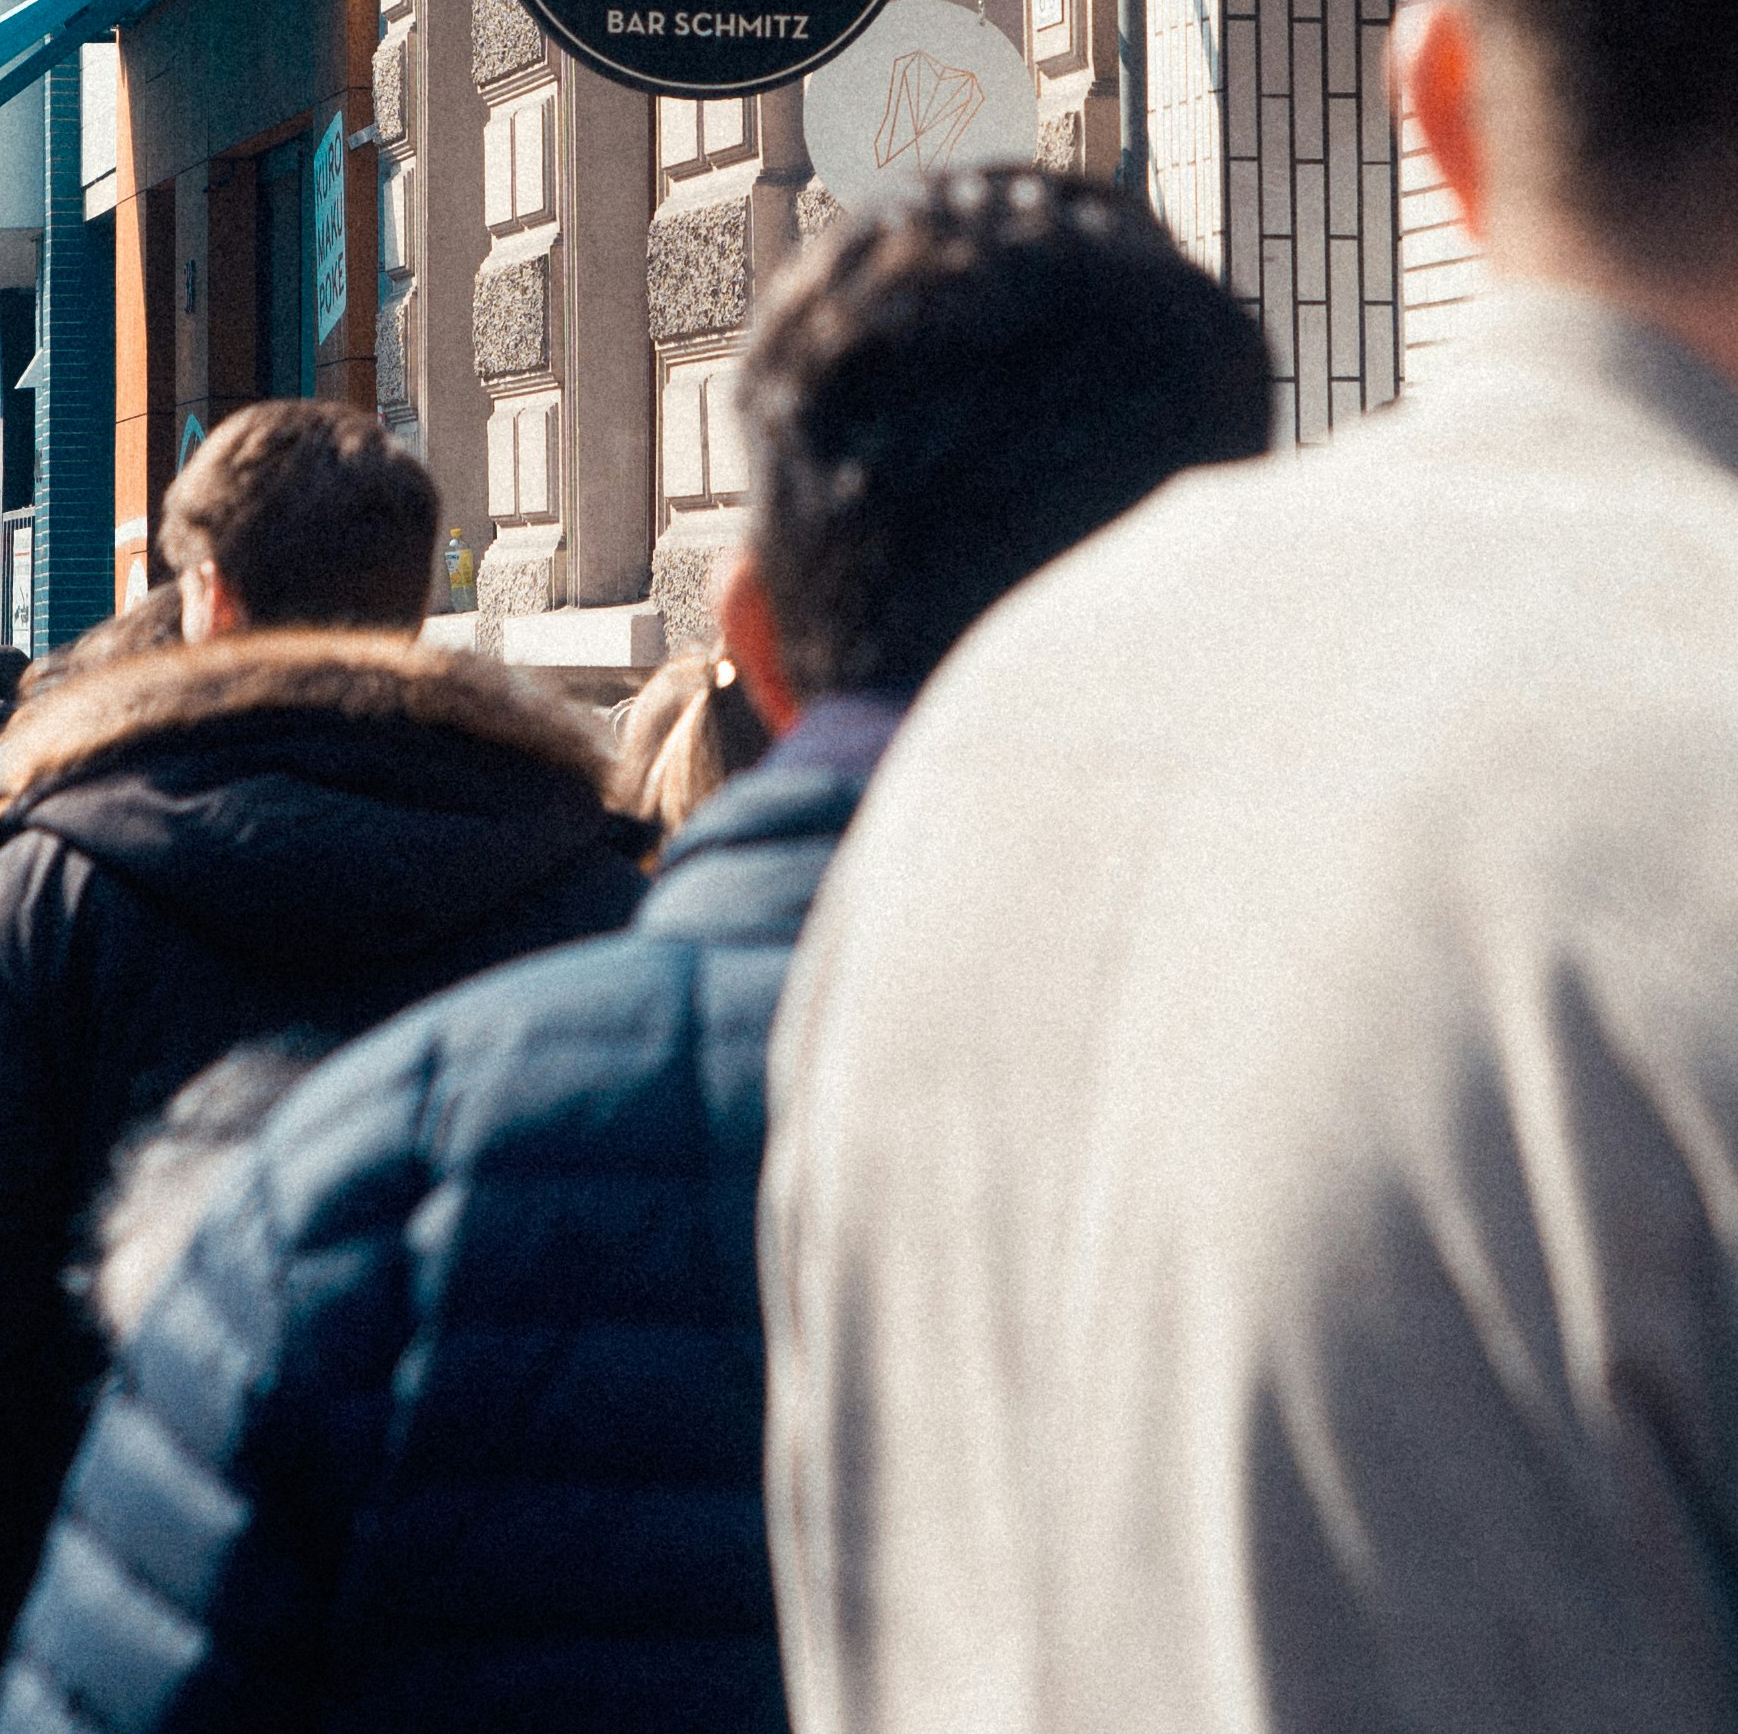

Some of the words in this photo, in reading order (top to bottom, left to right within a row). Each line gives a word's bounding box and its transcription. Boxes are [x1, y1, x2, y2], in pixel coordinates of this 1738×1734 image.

[607, 10, 665, 37] BAR
[674, 12, 809, 40] SCHMITZ
[316, 130, 342, 205] KURO
[317, 192, 343, 266] MAKU
[319, 252, 345, 325] POKE
